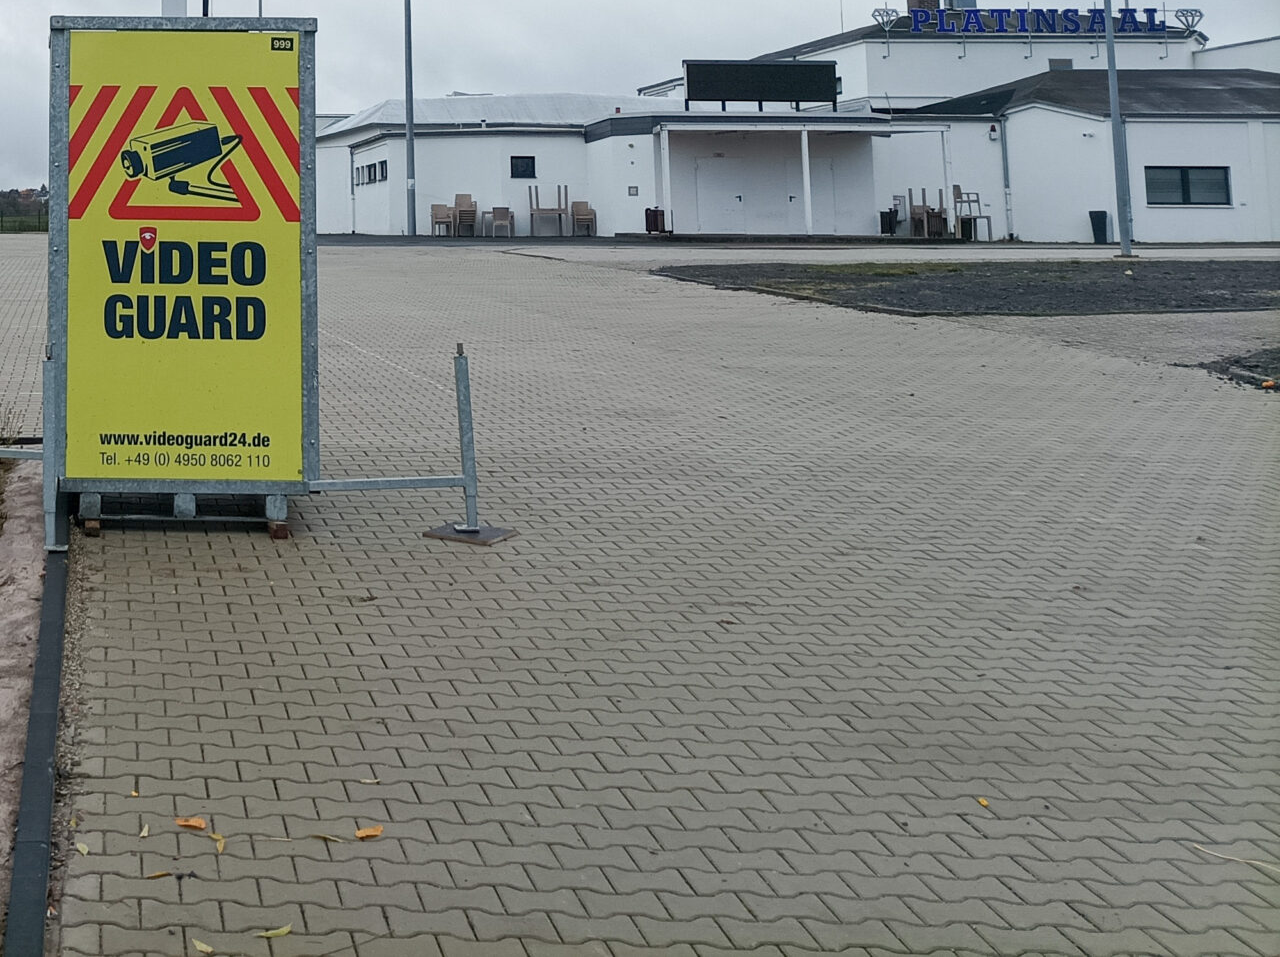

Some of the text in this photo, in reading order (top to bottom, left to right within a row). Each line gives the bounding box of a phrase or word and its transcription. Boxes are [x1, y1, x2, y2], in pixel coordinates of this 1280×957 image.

[910, 8, 1166, 33] PLATINSAAL
[273, 39, 291, 49] 999
[104, 294, 267, 340] GUARD
[99, 431, 271, 450] www.videoguard24.de
[99, 452, 270, 468] Tel. +49 (0) 4950 8062 110
